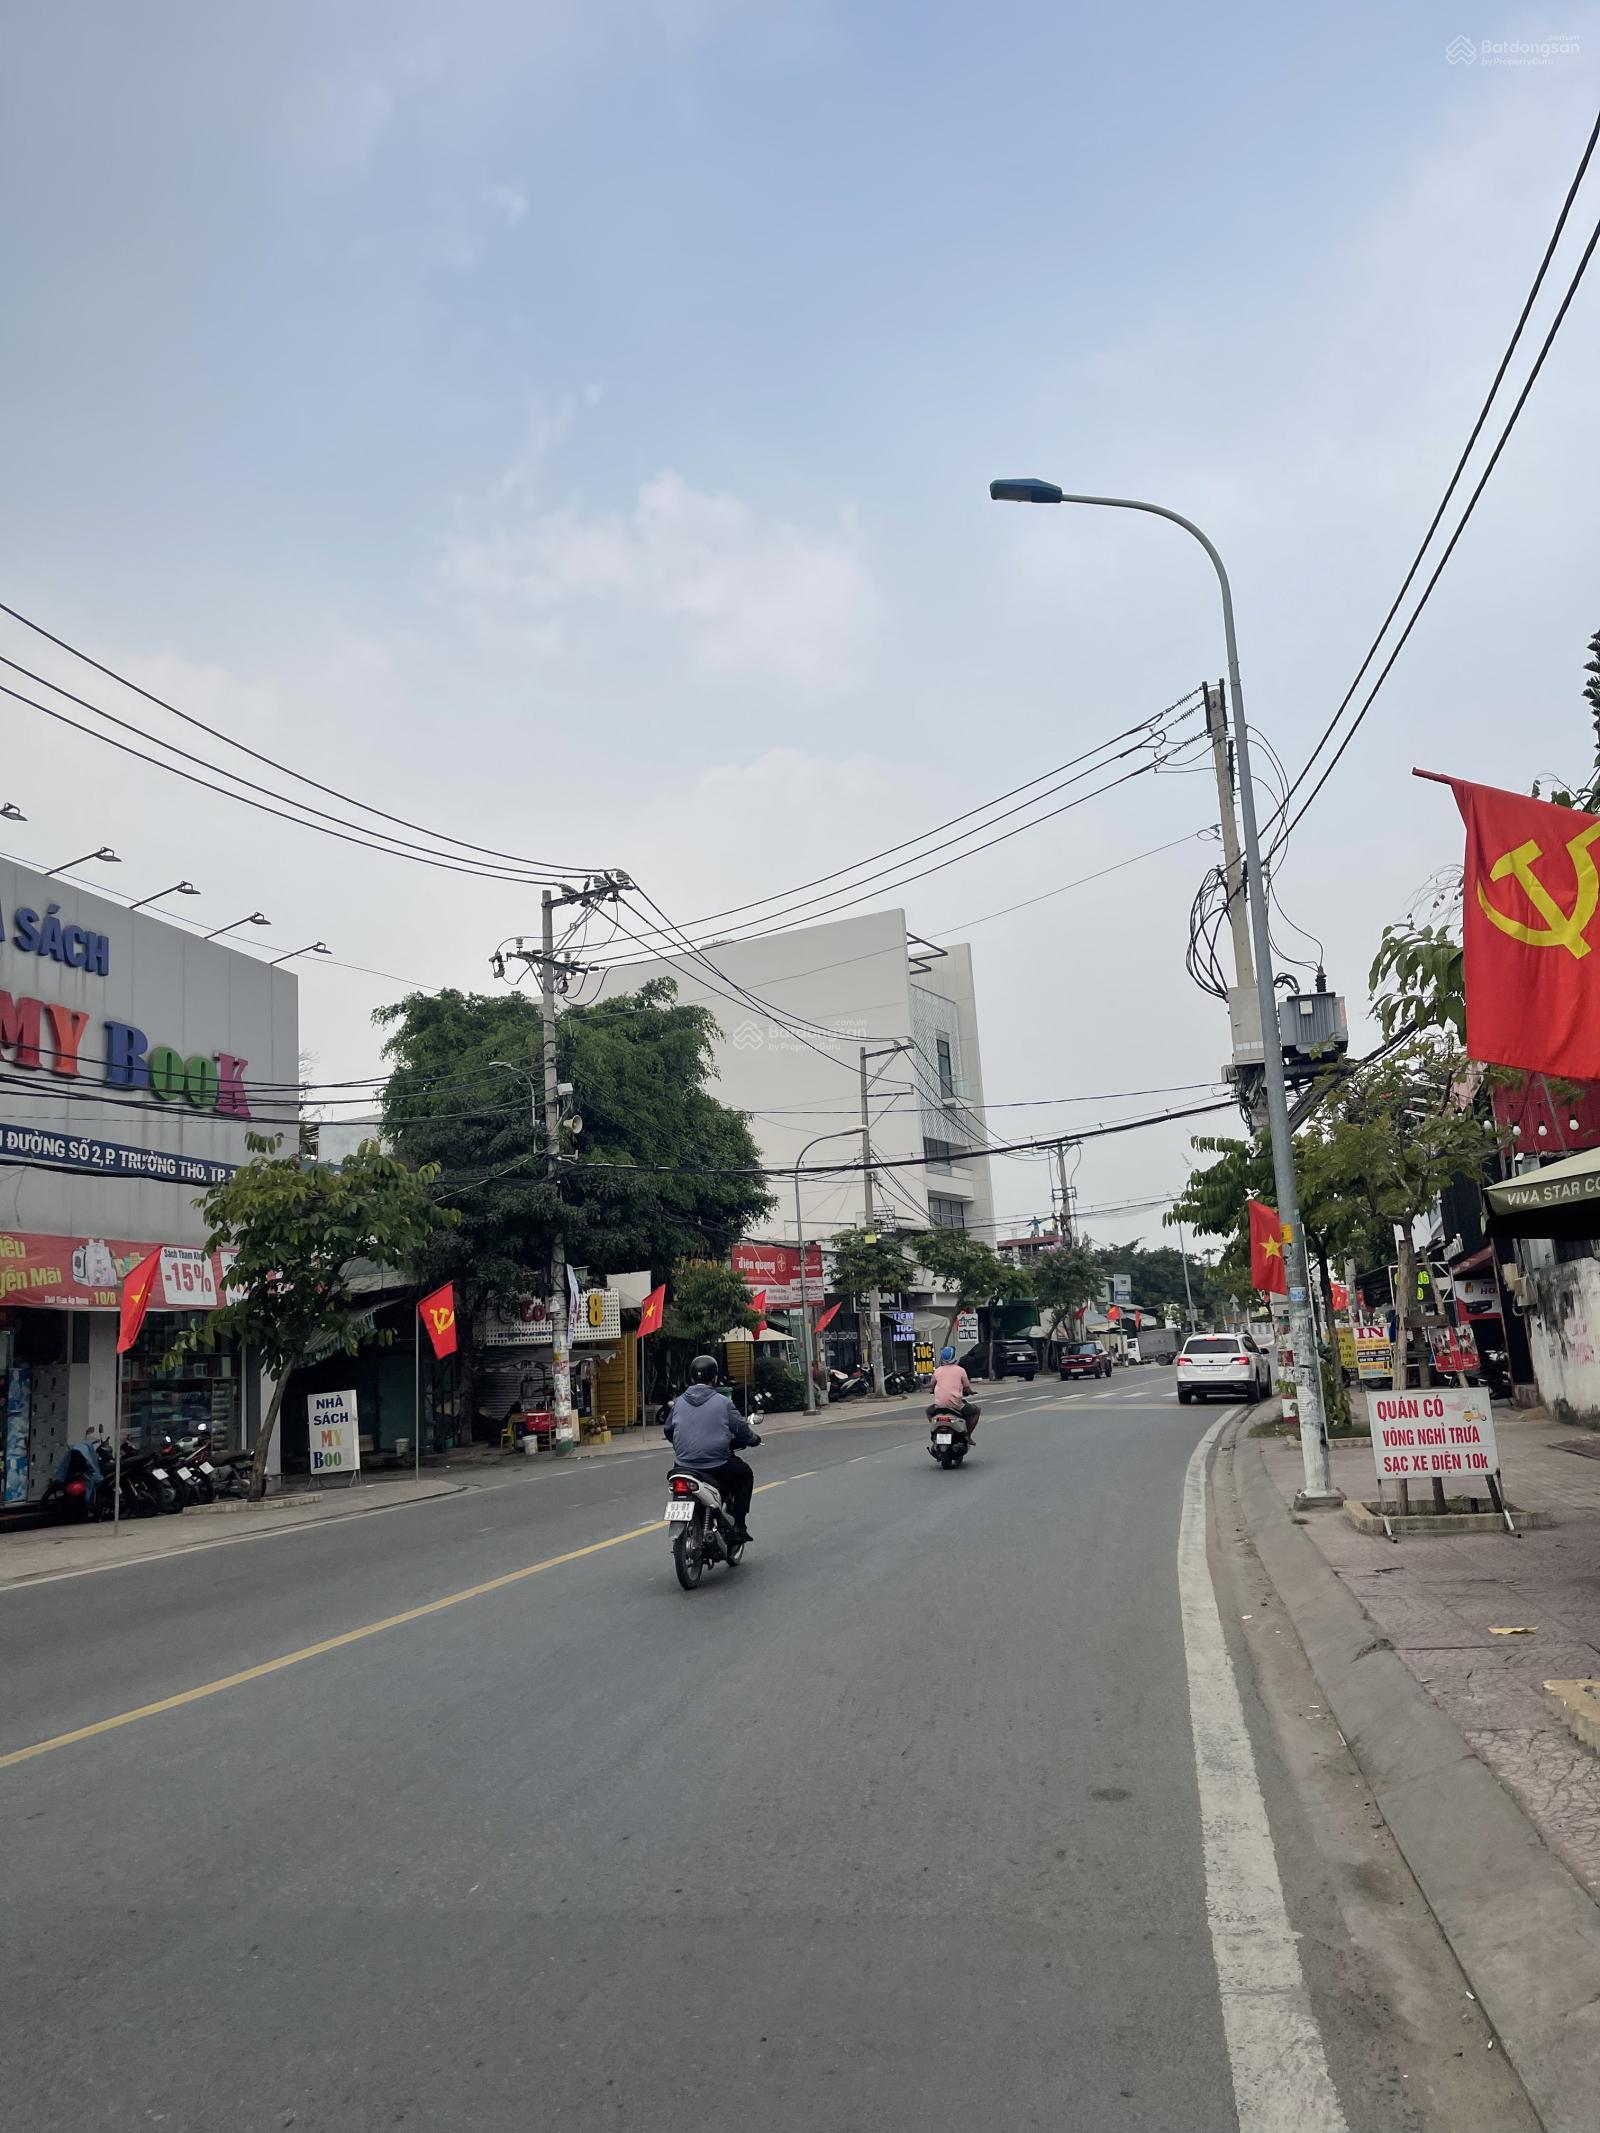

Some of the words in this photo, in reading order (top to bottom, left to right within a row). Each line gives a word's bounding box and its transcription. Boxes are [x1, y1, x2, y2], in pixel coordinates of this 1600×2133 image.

[13, 903, 109, 977] SÁCH
[0, 989, 90, 1079] MY
[7, 1130, 65, 1158] ĐƯỜNG
[68, 1138, 90, 1161] SỐ
[118, 1150, 176, 1175] TRƯỜNG
[1507, 1189, 1540, 1206] VIVA
[1543, 1181, 1580, 1201] STAR
[30, 1265, 63, 1288] Mãi
[164, 1262, 212, 1293] -15%
[587, 1293, 604, 1328] 8
[1356, 1326, 1385, 1339] IN
[316, 1394, 343, 1410] NHÀ
[1376, 1396, 1419, 1422] QUÁN
[1423, 1394, 1445, 1418] CÓ
[313, 1411, 349, 1426] SÁCH
[321, 1428, 343, 1448] MY
[1417, 1422, 1446, 1446] NGHỈ
[1448, 1424, 1481, 1444] TRƯA
[1383, 1455, 1409, 1476] SẠC
[1412, 1454, 1429, 1472] XE
[1431, 1450, 1462, 1474] ĐIỆN
